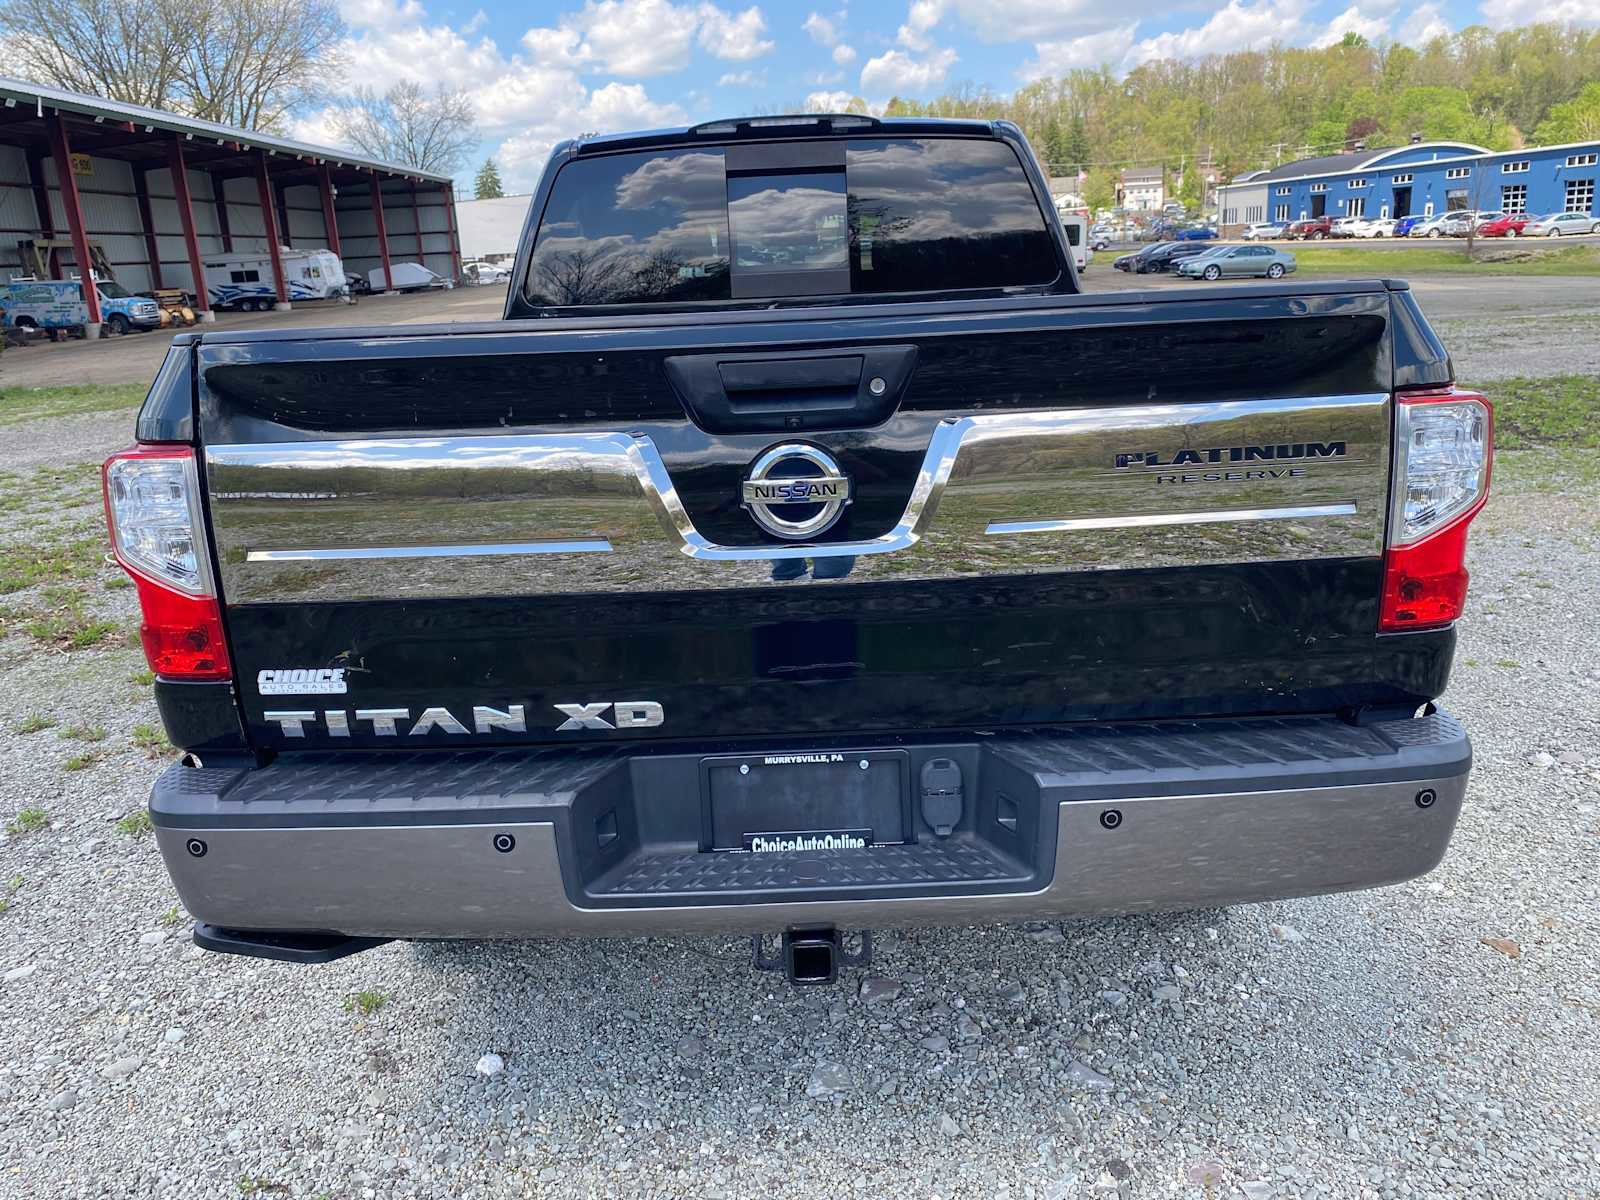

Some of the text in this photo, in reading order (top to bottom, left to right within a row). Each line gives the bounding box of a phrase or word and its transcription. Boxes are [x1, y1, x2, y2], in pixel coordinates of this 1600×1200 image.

[1115, 442, 1346, 468] PLATINUM
[1156, 468, 1306, 485] RESERVE
[755, 484, 837, 498] NISSAN
[258, 669, 345, 683] CHOICE
[264, 702, 664, 738] TITAN XD
[764, 754, 844, 764] MURRYSVILLE, PA
[752, 834, 865, 852] ChoiceAutoOnline
